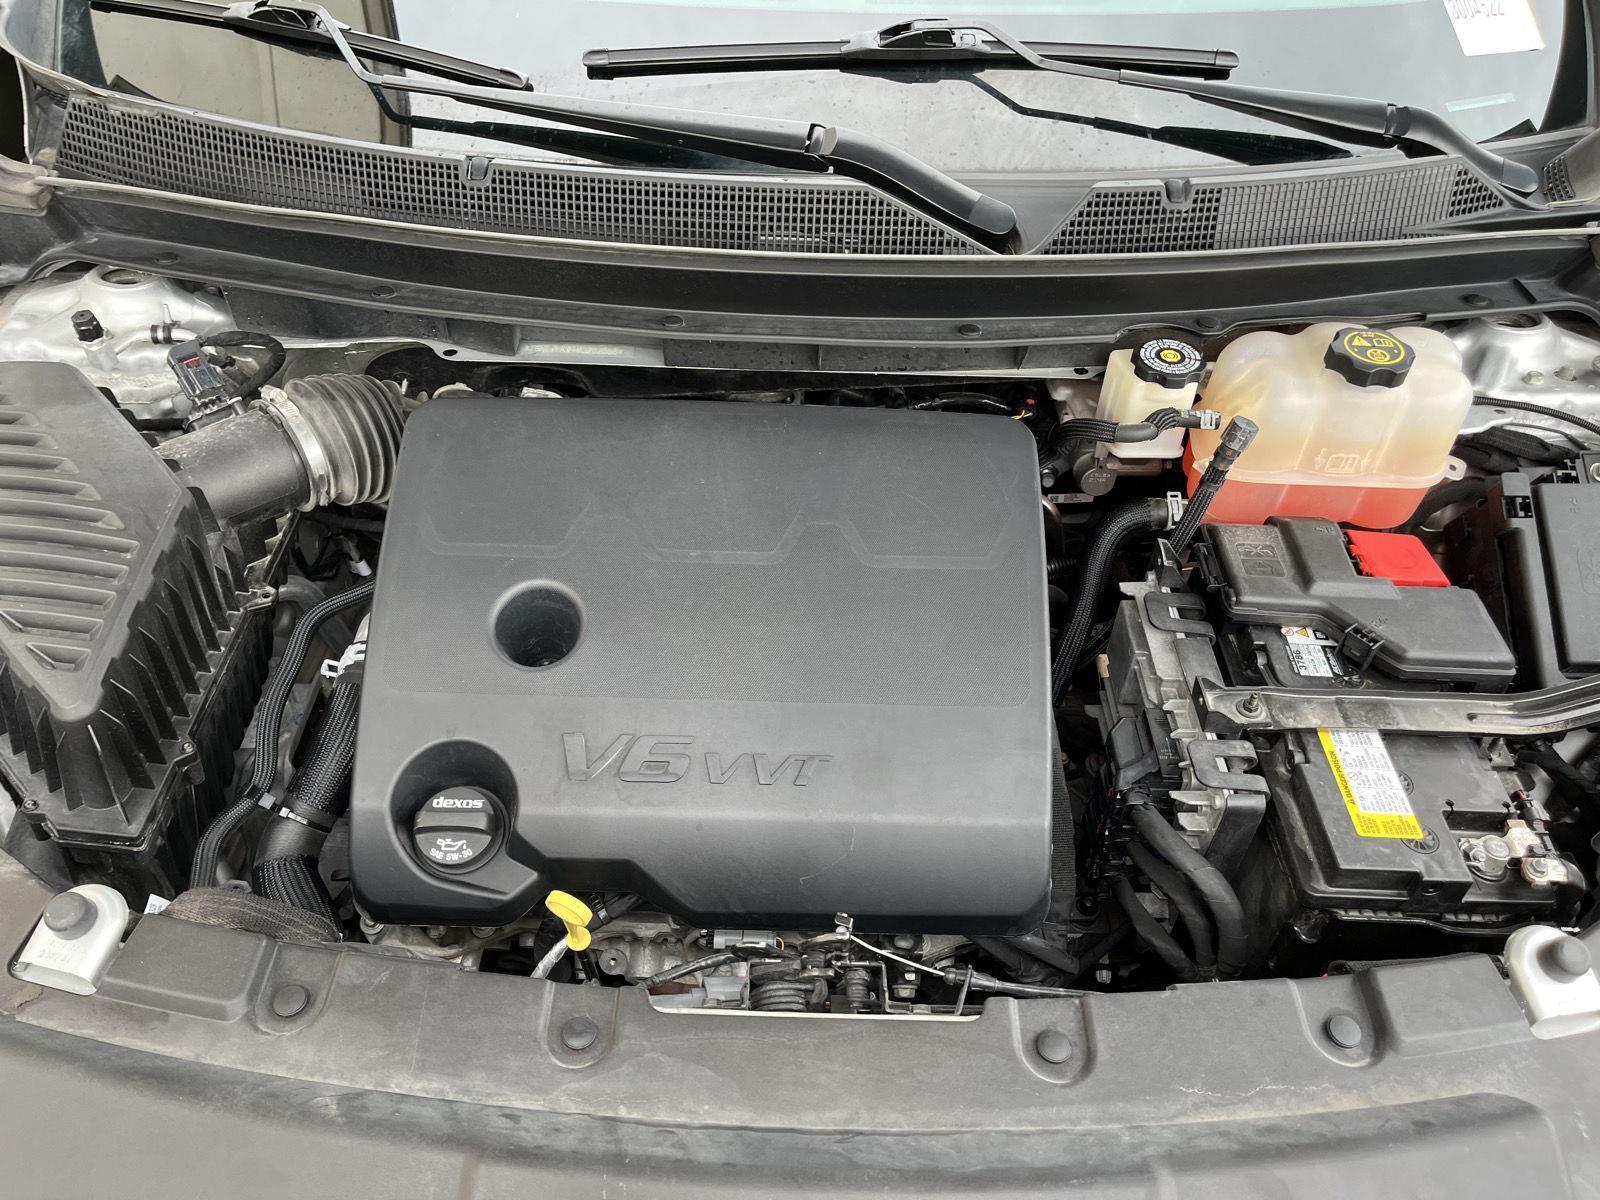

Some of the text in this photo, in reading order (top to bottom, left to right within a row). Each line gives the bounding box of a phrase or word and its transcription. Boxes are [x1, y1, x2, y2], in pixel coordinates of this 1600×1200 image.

[1292, 649, 1307, 671] 3786
[561, 732, 834, 787] V6 VVT
[432, 796, 486, 809] dexos
[429, 847, 473, 861] SAE 5W-30
